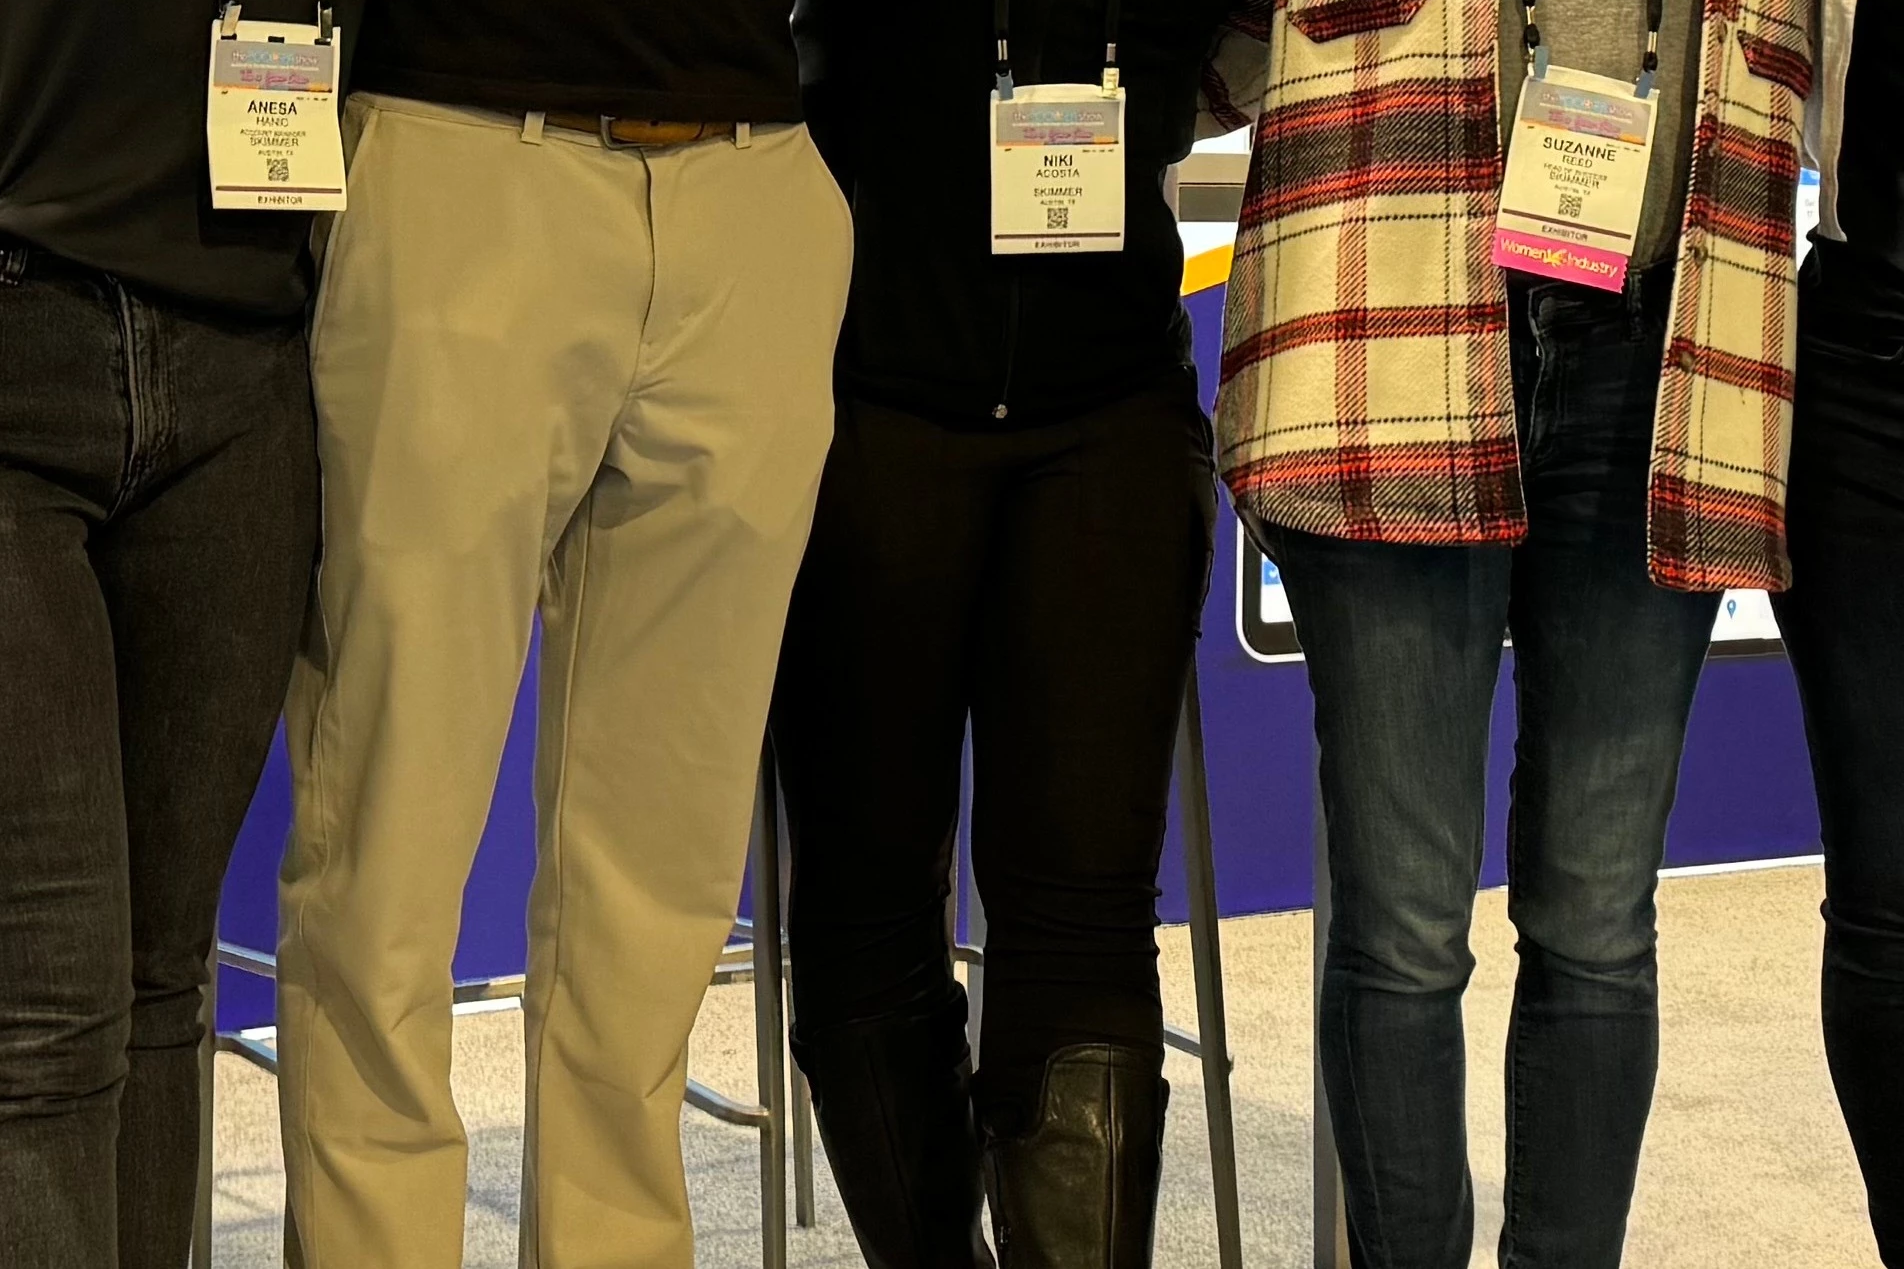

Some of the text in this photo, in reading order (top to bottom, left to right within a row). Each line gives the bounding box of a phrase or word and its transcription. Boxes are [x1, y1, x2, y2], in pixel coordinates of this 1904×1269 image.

[247, 100, 298, 116] ANESA
[1542, 136, 1617, 162] SUZANNE
[1043, 154, 1073, 167] NIKI
[1562, 154, 1593, 169] REED
[1035, 169, 1081, 178] ACOSTA
[1034, 187, 1083, 197] SKIMMER
[1541, 225, 1589, 242] EXHIBITOR
[1500, 237, 1618, 278] Women Industry
